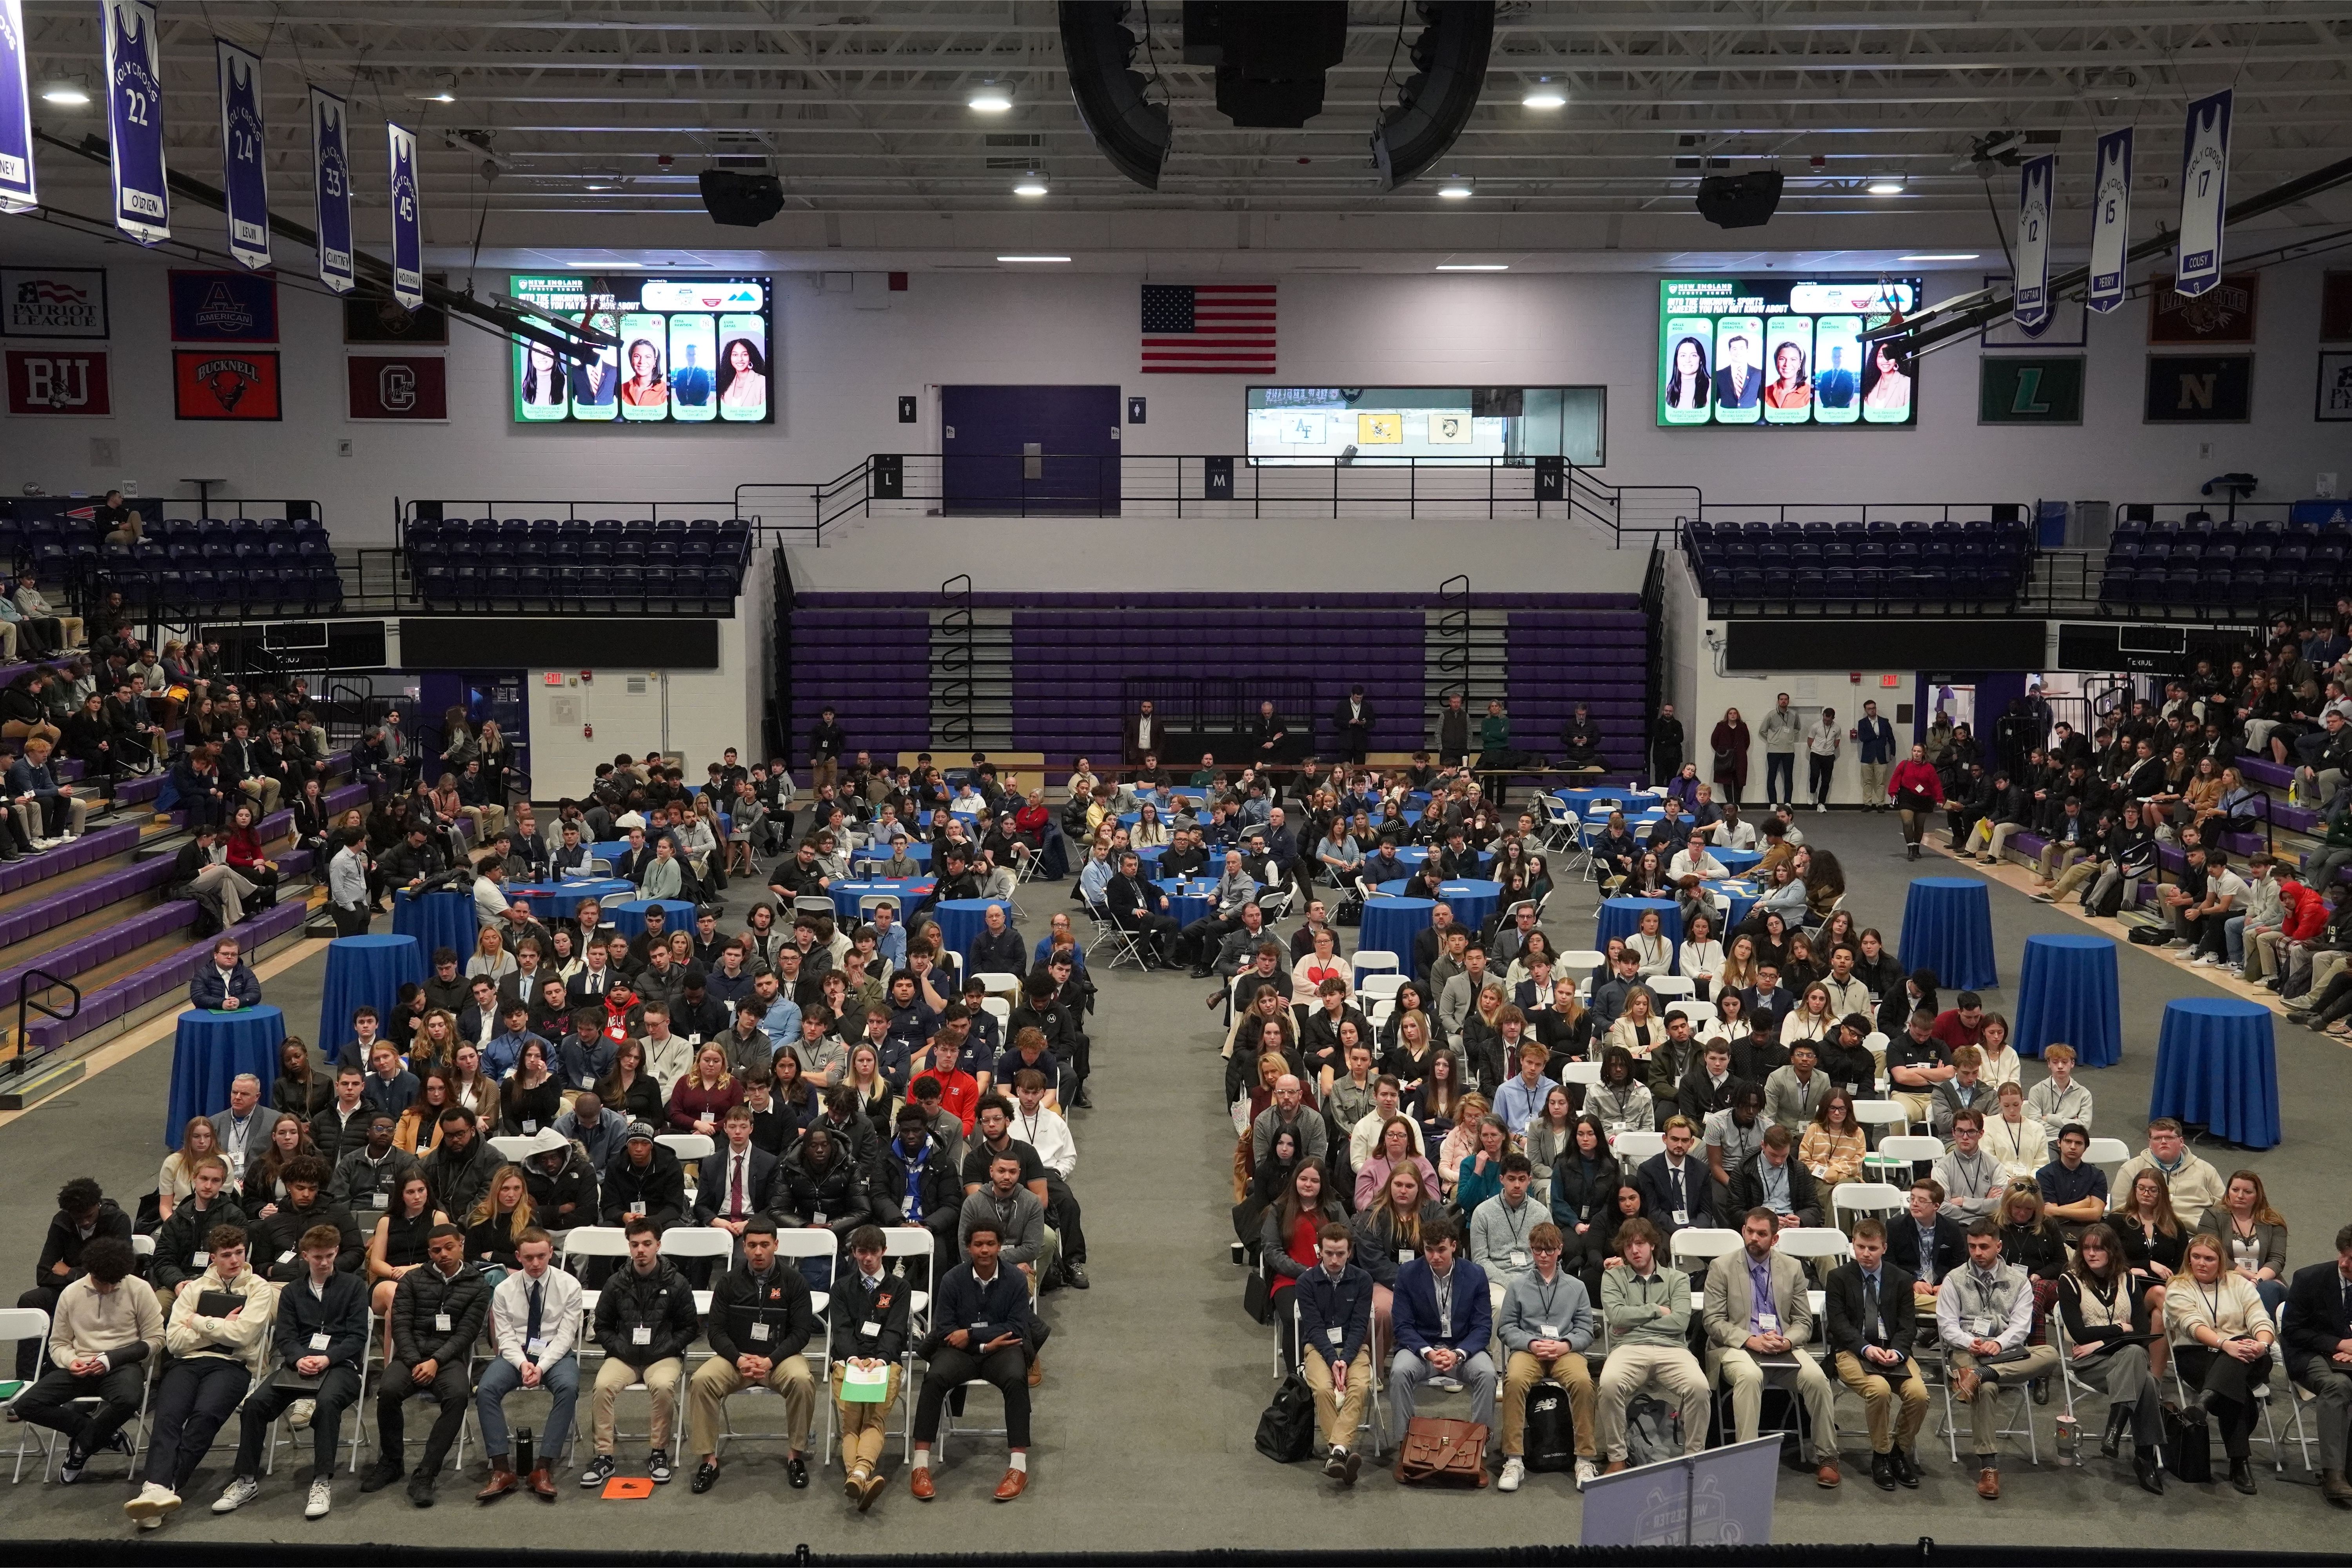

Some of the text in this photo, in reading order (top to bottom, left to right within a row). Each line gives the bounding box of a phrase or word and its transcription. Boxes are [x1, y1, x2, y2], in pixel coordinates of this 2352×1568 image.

[132, 63, 158, 102] CROSS
[125, 89, 148, 126] 22
[241, 107, 262, 142] CROSS
[236, 131, 253, 163] 24
[2188, 147, 2222, 179] HOLY CROSS
[326, 167, 341, 196] 33
[403, 176, 416, 204] CROSS
[2111, 178, 2125, 201] CROSS
[2198, 170, 2210, 198] 17
[132, 195, 158, 212] O'BRIEN
[399, 196, 412, 222] 45
[2033, 200, 2046, 221] CROSS
[2105, 199, 2116, 224] 15
[242, 226, 257, 241] LEVIN
[2029, 220, 2038, 242] 12
[2189, 254, 2208, 268] COUSY
[2099, 275, 2115, 289] PERRY
[1699, 298, 1736, 306] UNKNOWN:
[2020, 289, 2038, 301] KAFTAN
[13, 304, 97, 316] PATRIOT
[200, 313, 250, 323] AMERICAN
[1713, 305, 1728, 313] MAY
[1765, 305, 1788, 313] ABOUT
[13, 315, 97, 327] LEAGUE
[25, 358, 89, 406] BU
[197, 360, 259, 383] BUCKNELL
[380, 365, 416, 412] C
[2011, 368, 2051, 413] L
[2177, 374, 2217, 409] N
[886, 473, 892, 485] L
[1213, 474, 1226, 486] M
[1544, 475, 1555, 487] N
[547, 673, 561, 684] EXIT
[1883, 675, 1897, 686] EXIT
